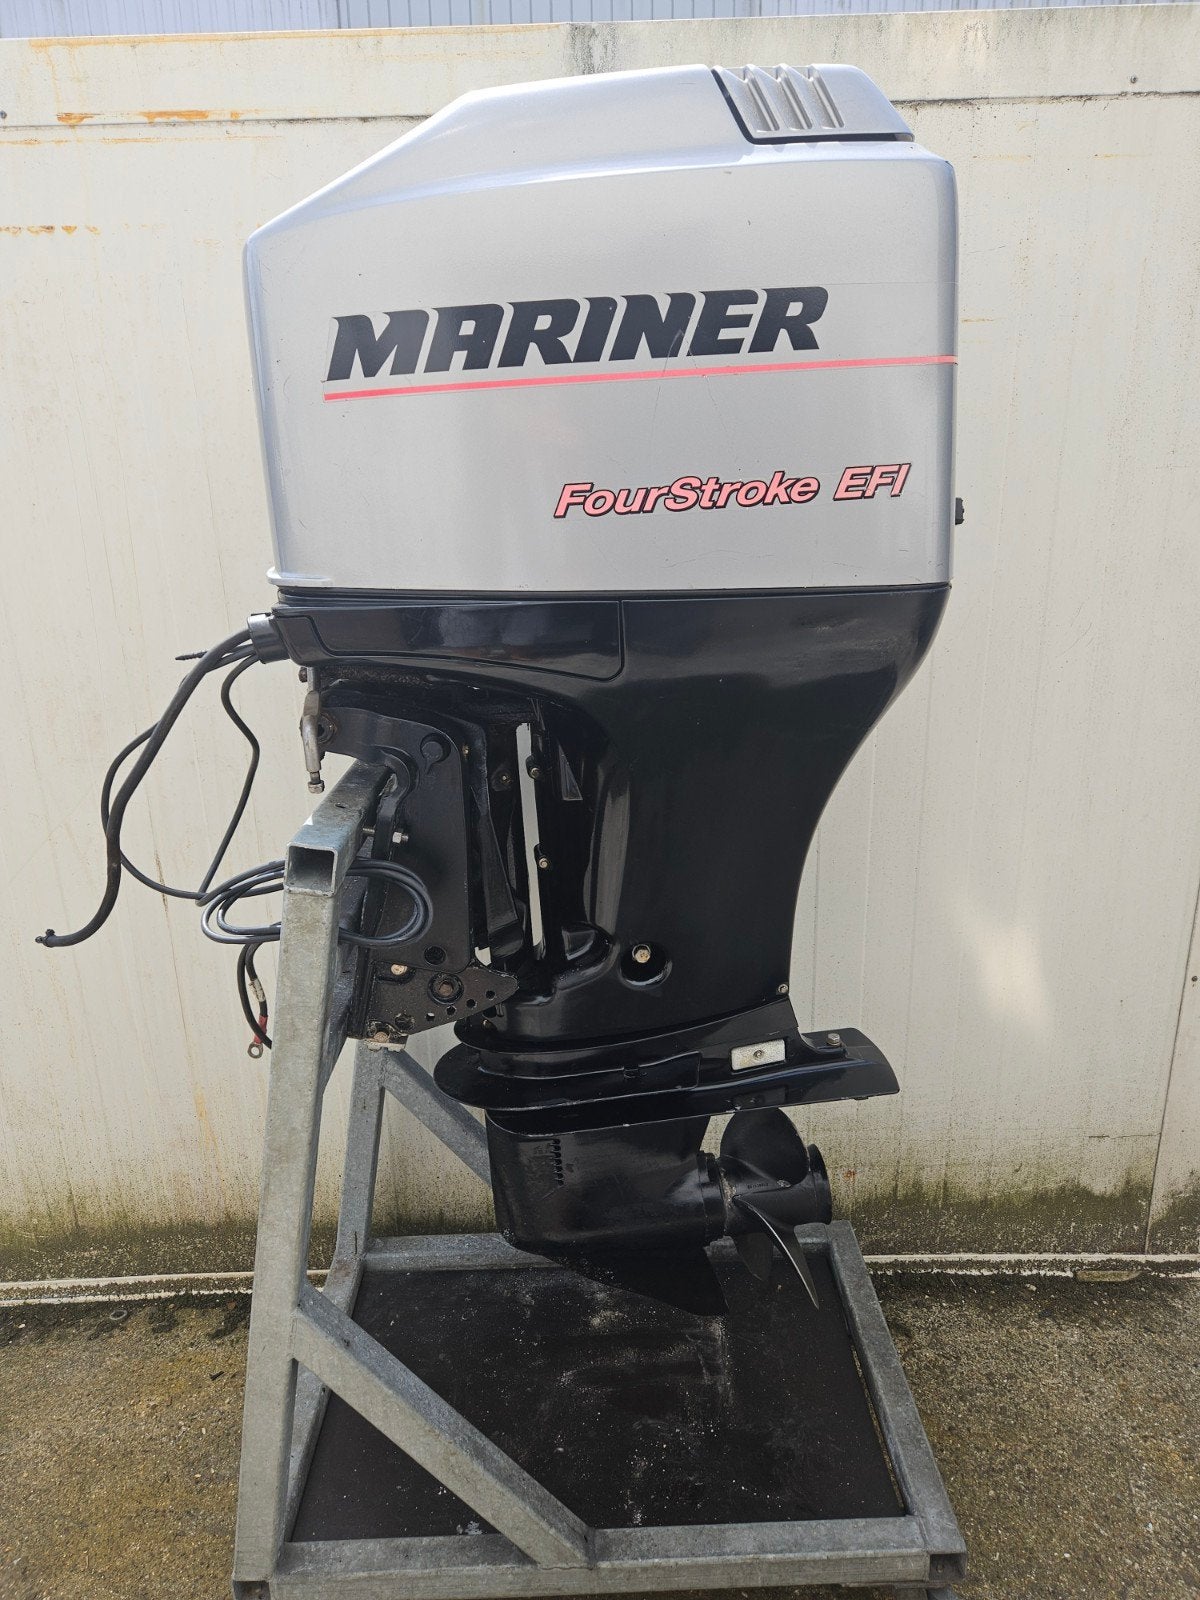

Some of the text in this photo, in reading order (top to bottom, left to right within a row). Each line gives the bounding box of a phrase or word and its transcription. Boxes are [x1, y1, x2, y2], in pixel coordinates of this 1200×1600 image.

[326, 286, 829, 381] MARINER
[553, 463, 911, 519] FourStroke EFI
